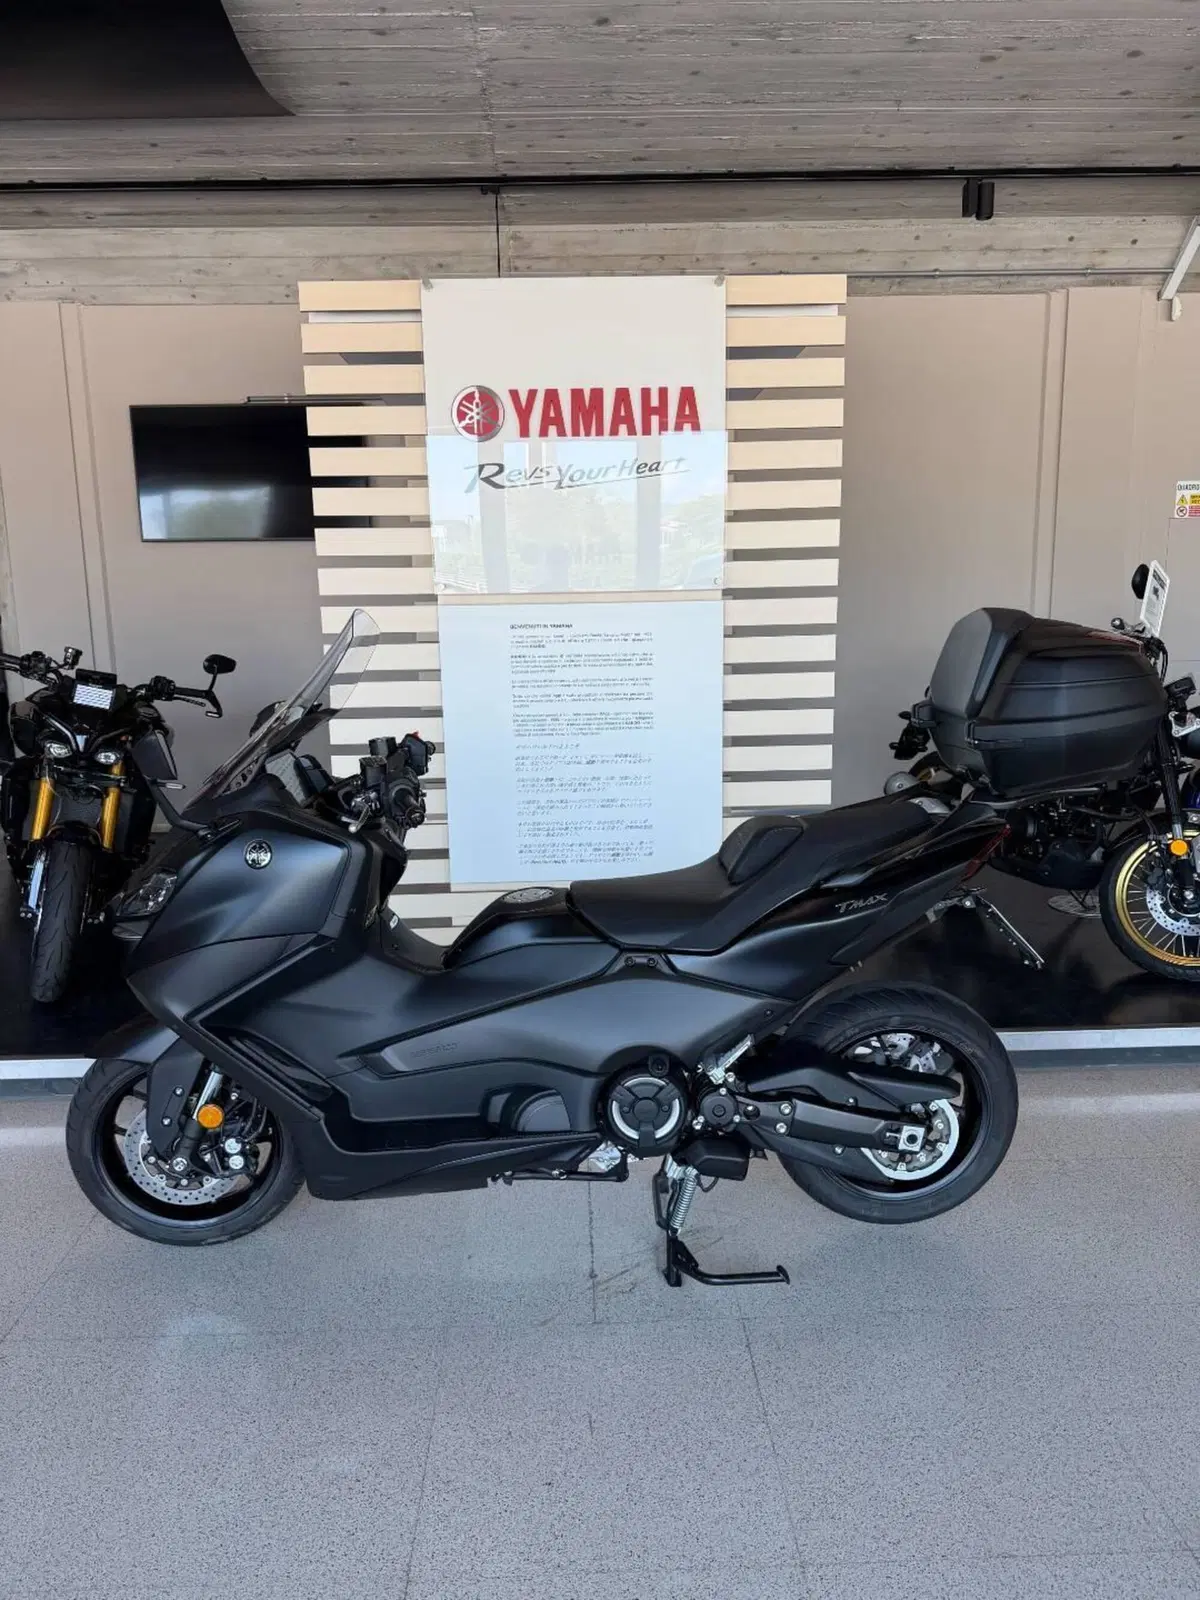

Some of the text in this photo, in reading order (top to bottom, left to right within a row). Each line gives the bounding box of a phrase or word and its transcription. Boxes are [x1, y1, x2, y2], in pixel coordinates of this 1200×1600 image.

[508, 386, 701, 438] YAMAHA
[464, 457, 687, 493] Revs Your Heart
